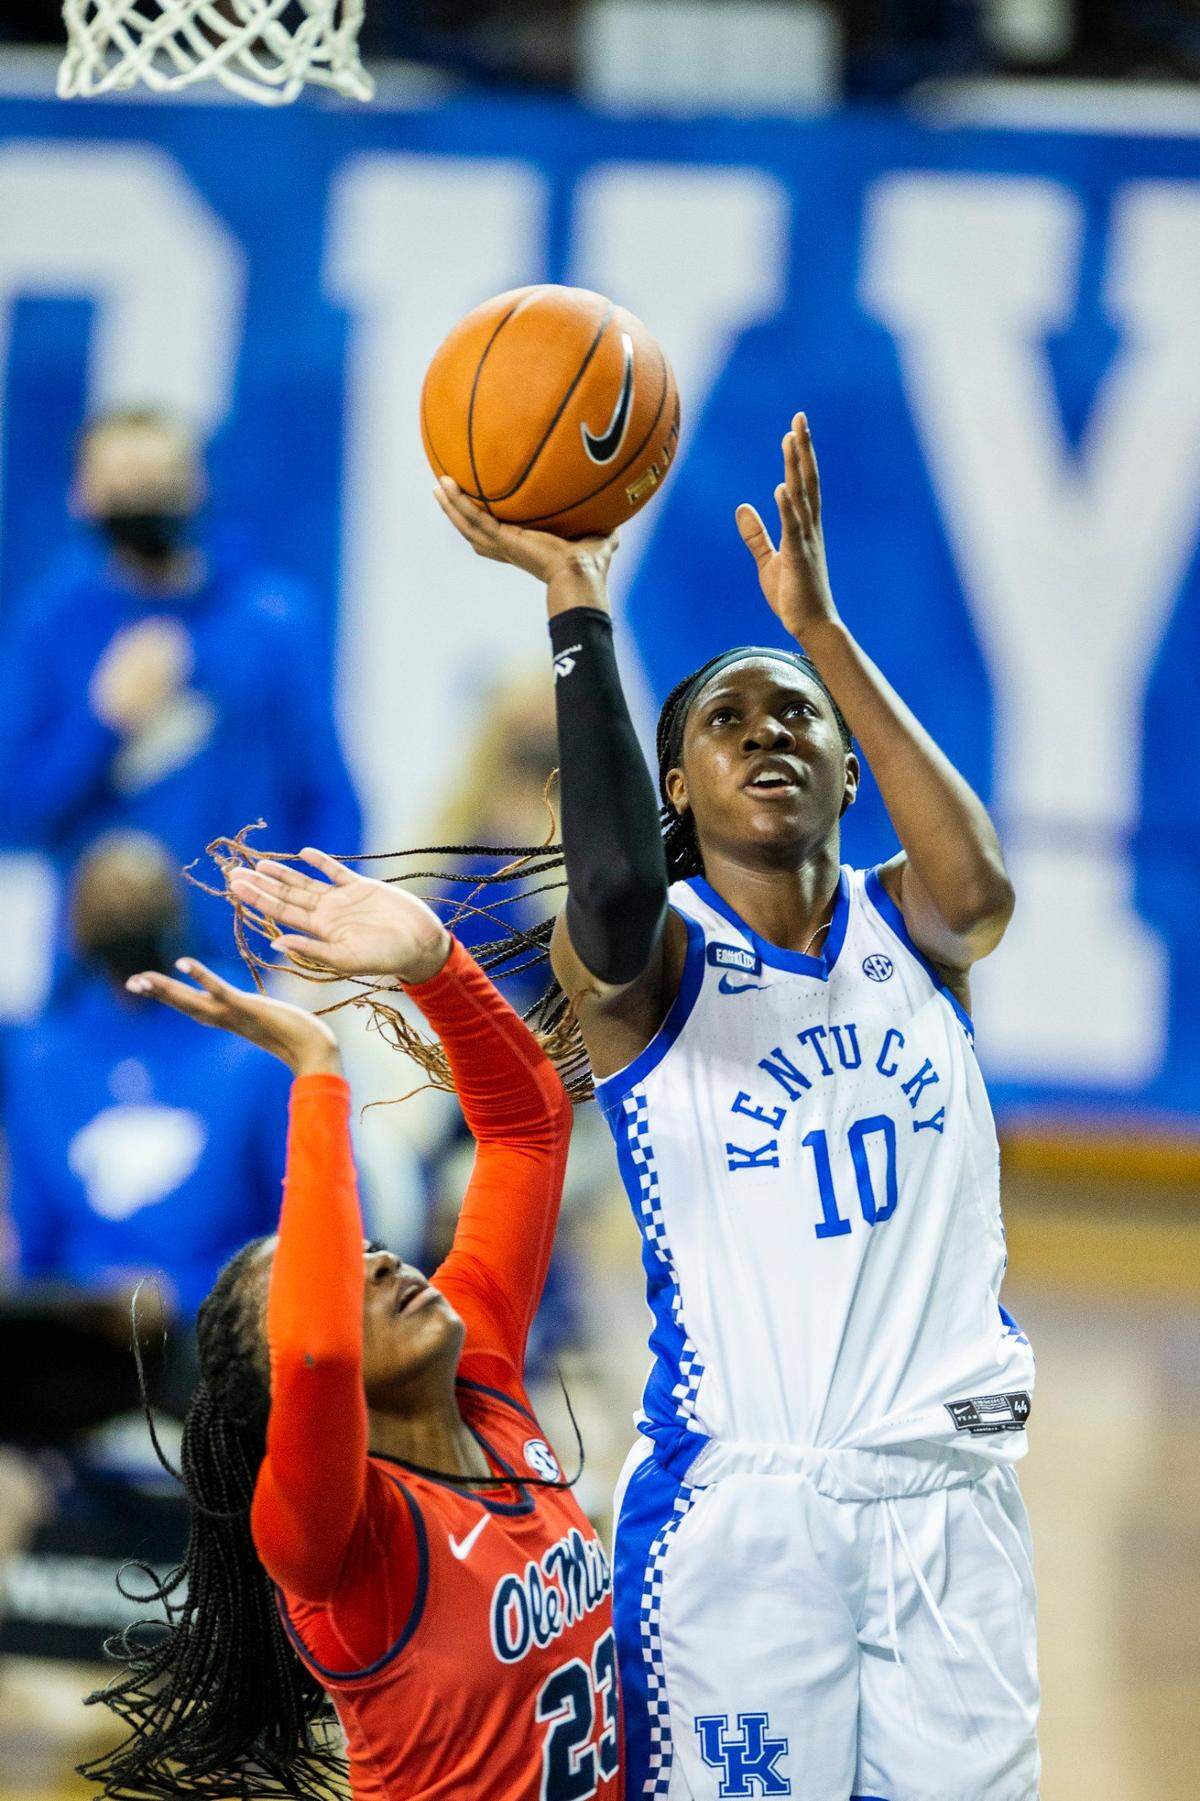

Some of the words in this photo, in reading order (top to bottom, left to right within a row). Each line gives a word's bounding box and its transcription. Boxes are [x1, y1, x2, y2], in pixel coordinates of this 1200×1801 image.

[864, 955, 892, 981] SEC
[726, 1022, 946, 1172] KENTUCKY
[801, 1114, 899, 1239] 10
[1014, 1400, 1028, 1414] 44
[490, 1560, 564, 1664] Ole
[534, 1626, 619, 1801] 23
[694, 1712, 791, 1798] UK
